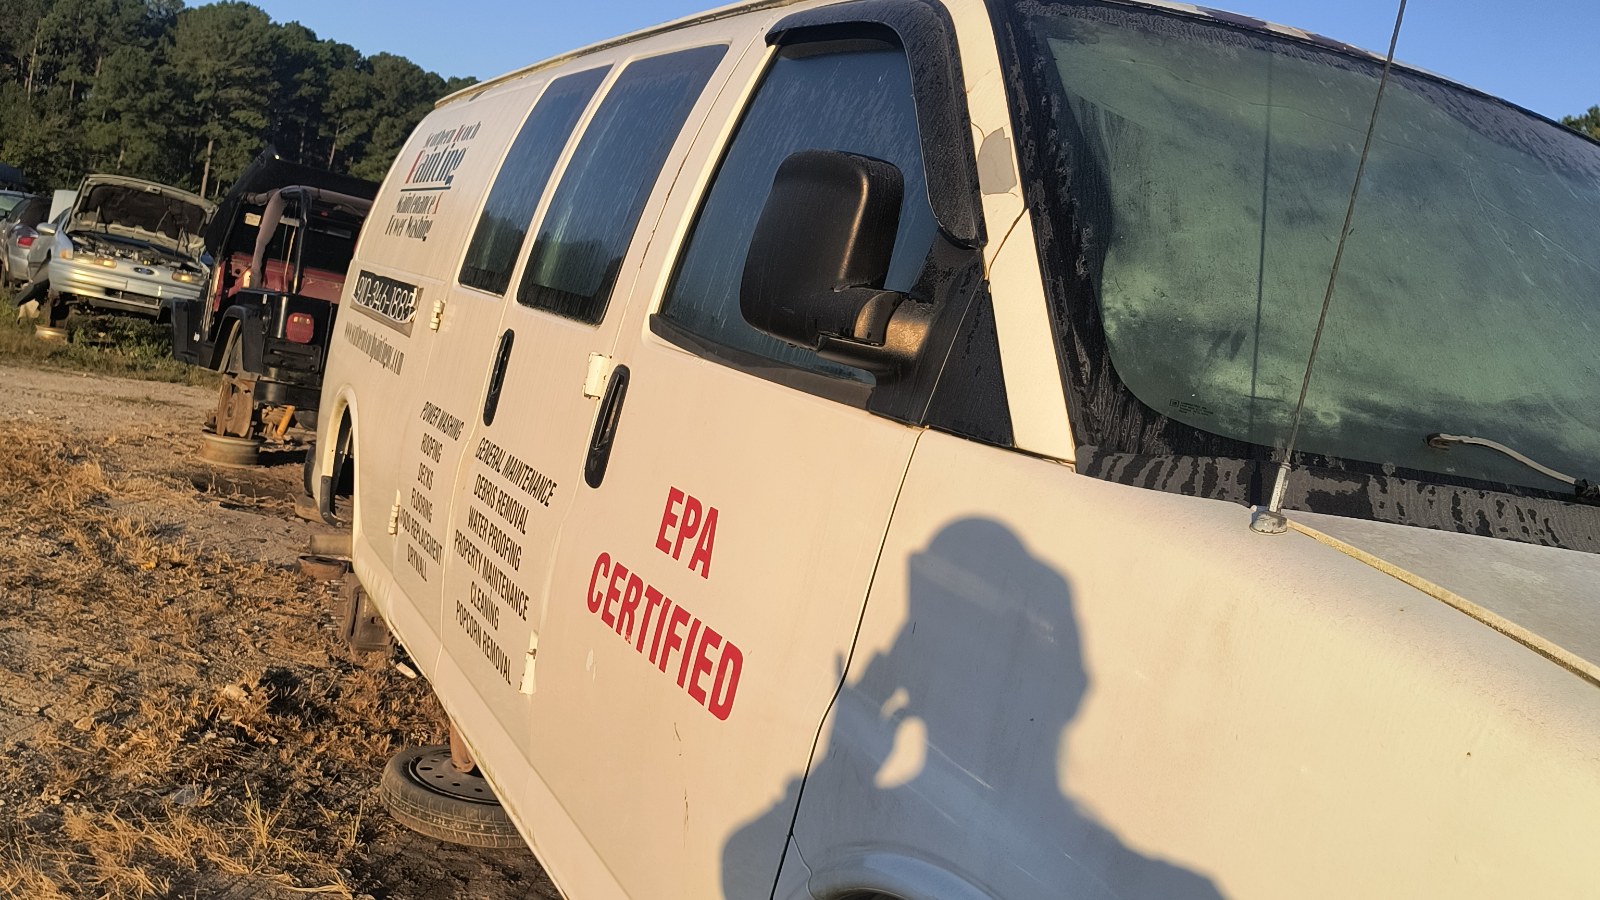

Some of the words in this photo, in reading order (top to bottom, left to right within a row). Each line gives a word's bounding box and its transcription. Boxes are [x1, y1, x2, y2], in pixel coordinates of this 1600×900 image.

[406, 144, 468, 185] Painting
[420, 401, 442, 427] POWER
[436, 408, 465, 441] WASHING
[420, 432, 443, 463] ROOFING
[417, 462, 434, 490] DECKS
[475, 437, 507, 473] GENERAL
[501, 454, 558, 508] MAINTENANCE
[473, 473, 499, 509] DEBRIS
[494, 490, 530, 535] REMOVAL
[410, 517, 443, 565] REPLACEMENT
[467, 505, 490, 542] WATER
[488, 522, 522, 572] PROOFING
[655, 486, 719, 580] EPA
[407, 543, 428, 582] DRYWALL
[454, 529, 483, 574] PROPERTY
[482, 556, 530, 622] MAINTENANCE
[470, 581, 500, 631] CLEANING
[456, 600, 482, 648] POPCORN
[482, 630, 512, 686] REMOVAL
[586, 551, 744, 721] CERTIFIED
